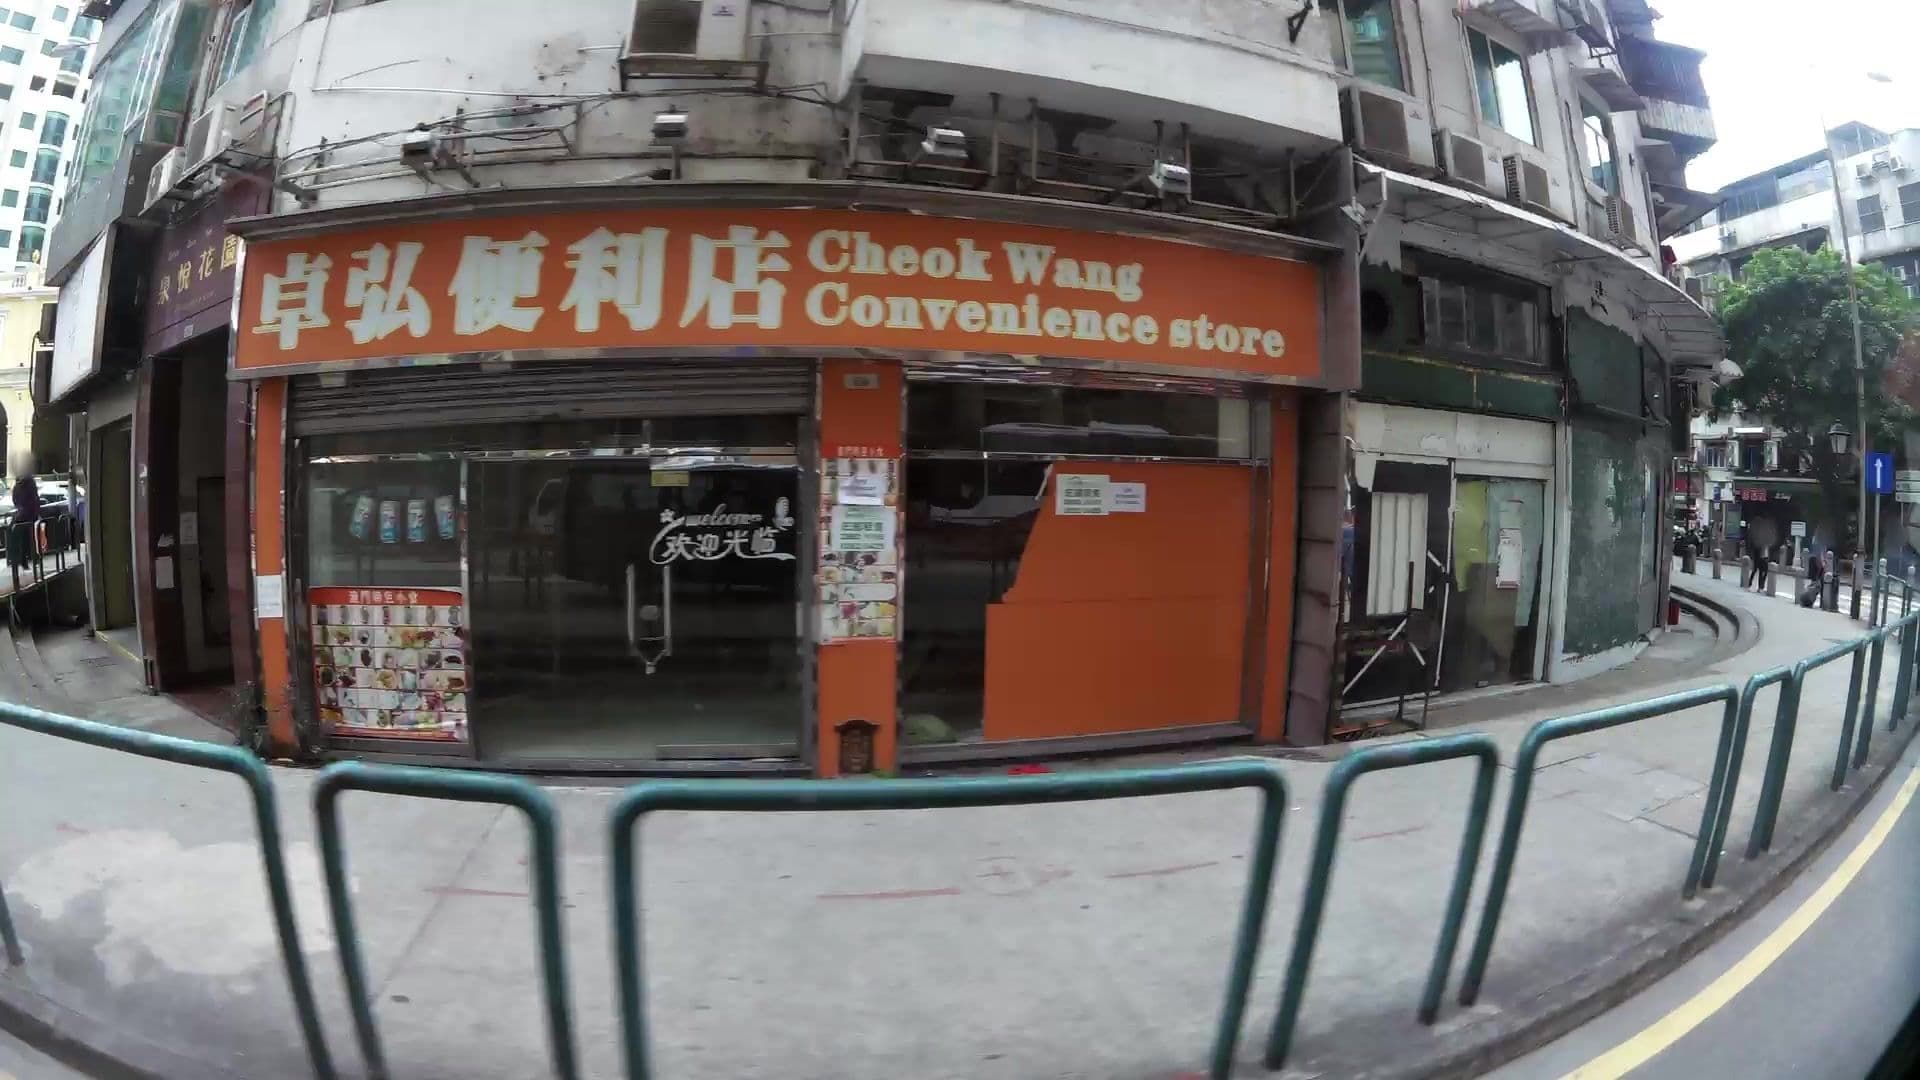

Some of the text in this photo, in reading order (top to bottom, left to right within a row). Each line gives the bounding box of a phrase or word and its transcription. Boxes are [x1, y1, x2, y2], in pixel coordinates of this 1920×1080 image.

[252, 225, 791, 350] 卓弘便利店
[806, 229, 1144, 301] Cheok Wang
[805, 281, 1286, 358] Convenience store
